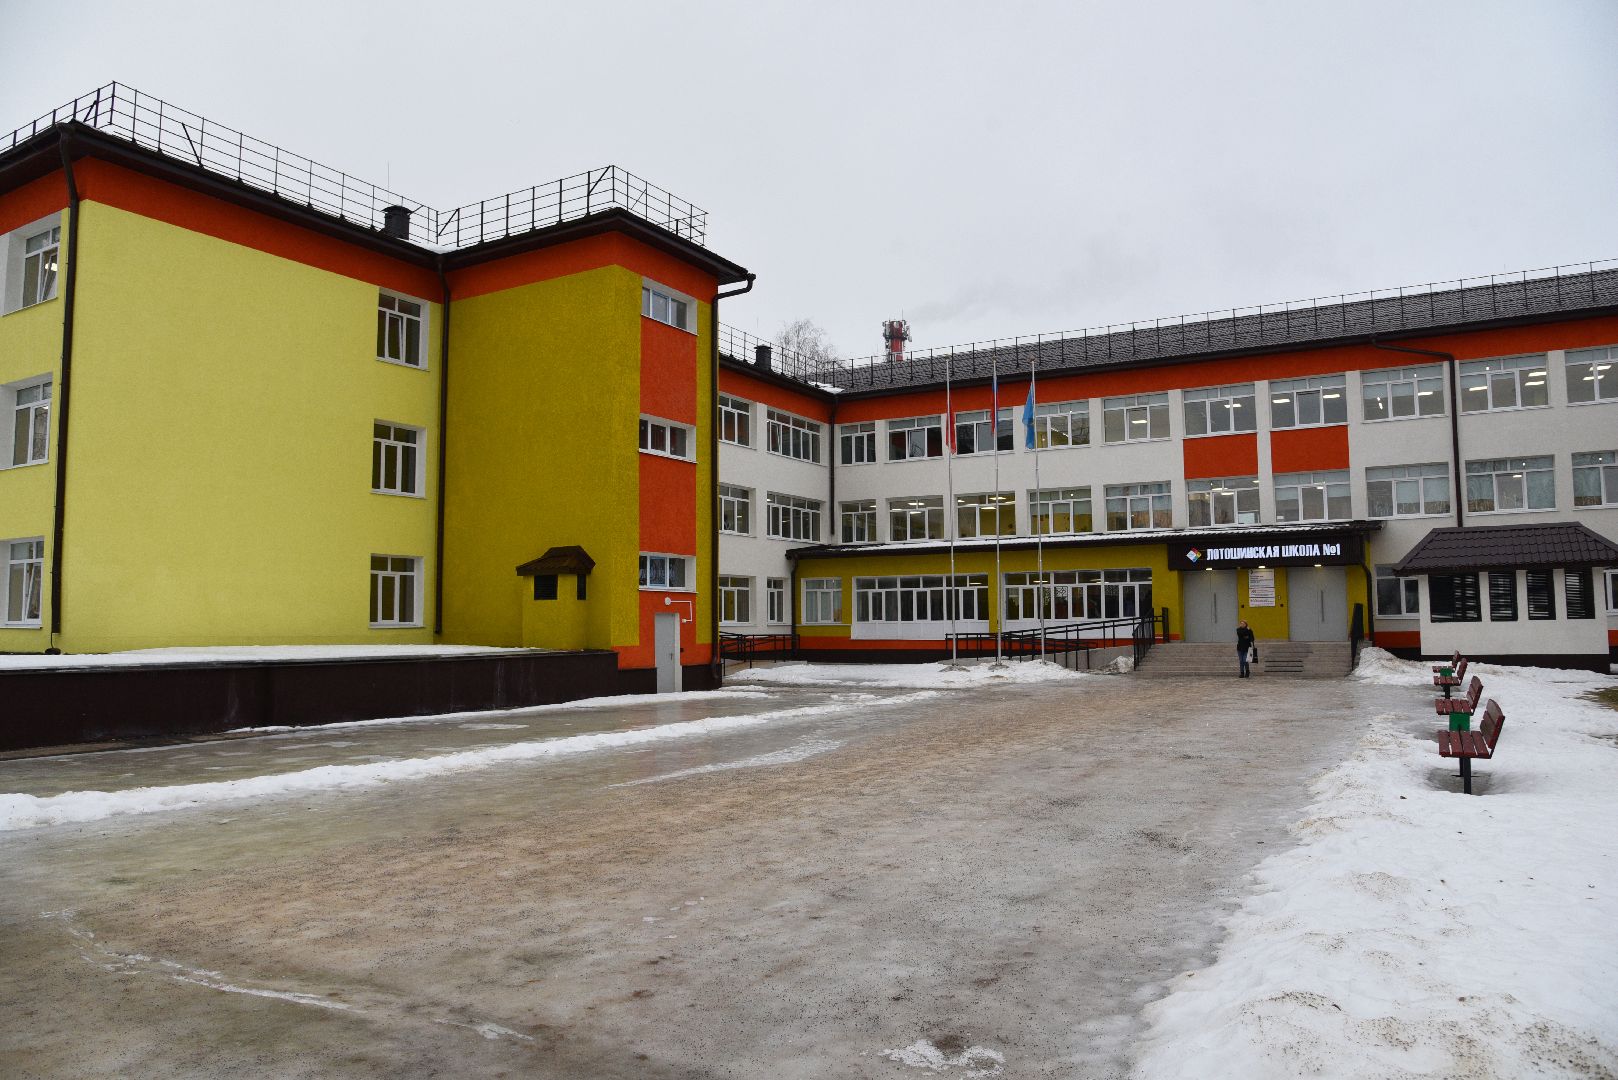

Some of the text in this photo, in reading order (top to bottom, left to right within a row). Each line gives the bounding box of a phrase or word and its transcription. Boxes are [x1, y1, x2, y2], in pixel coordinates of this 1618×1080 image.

[1206, 543, 1341, 560] ЛОТОШИНСКАЯ ШКОЛА №1
